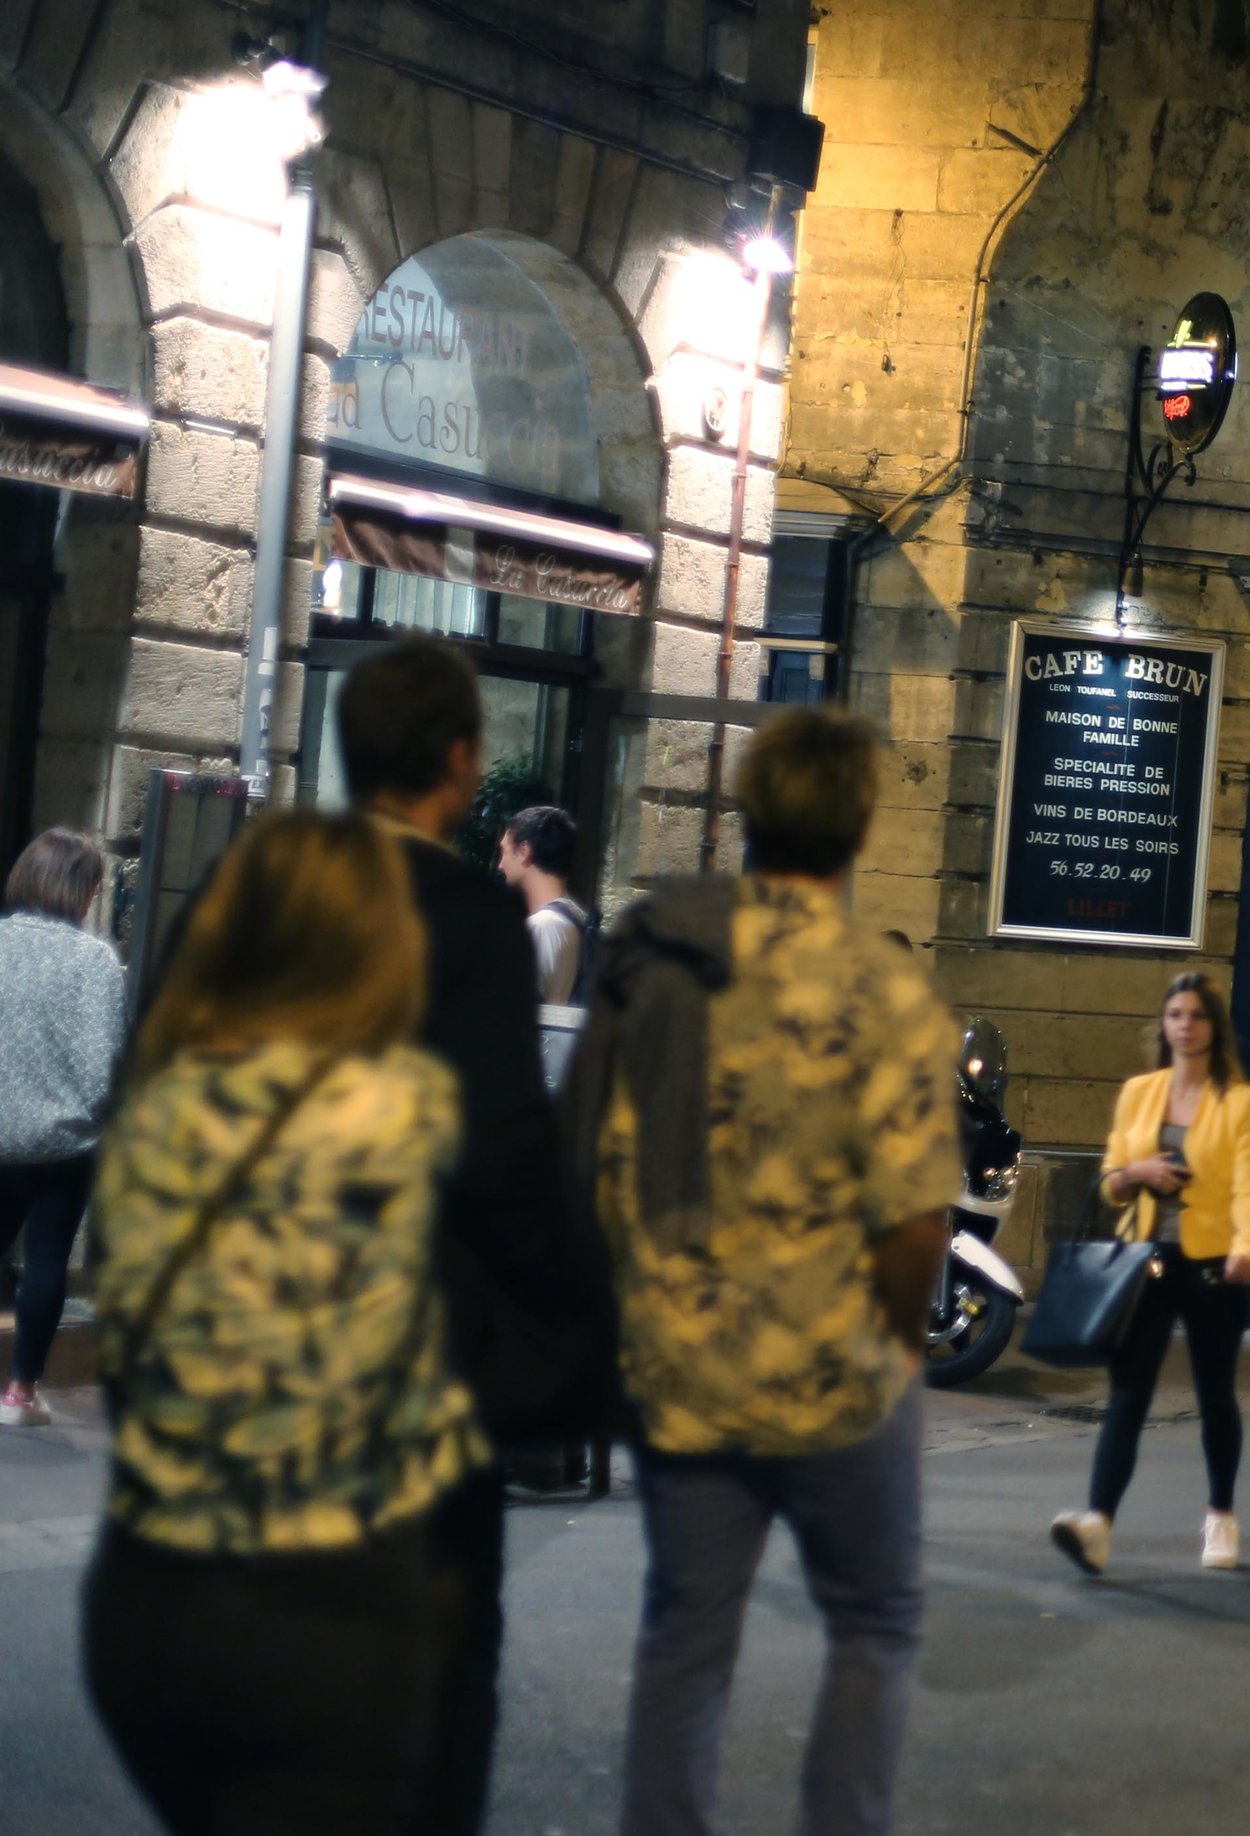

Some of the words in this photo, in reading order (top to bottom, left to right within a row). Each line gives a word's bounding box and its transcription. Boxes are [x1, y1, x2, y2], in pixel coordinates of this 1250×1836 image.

[1024, 650, 1104, 681] CAFE
[1124, 653, 1208, 697] BRUN
[1049, 683, 1071, 693] LEON
[1077, 685, 1117, 697] TOUFANEL
[1127, 690, 1180, 703] SUCCESSEUR
[1045, 710, 1101, 728] MAISON
[1108, 716, 1126, 729] DE
[1132, 718, 1179, 734] BONNE
[1083, 731, 1140, 747] FAMILLE
[1144, 766, 1164, 779] DE
[1044, 774, 1093, 789] BIERES
[1100, 778, 1170, 796] PRESSION
[1033, 803, 1067, 818] VINS
[1073, 807, 1093, 820] DE
[1097, 808, 1179, 828] BORDEAUX
[1025, 831, 1060, 845] JAZZ
[1065, 833, 1100, 848] TOUS
[1104, 836, 1129, 850] LES
[1135, 839, 1180, 855] SOIRS
[1066, 897, 1132, 918] LILLET
